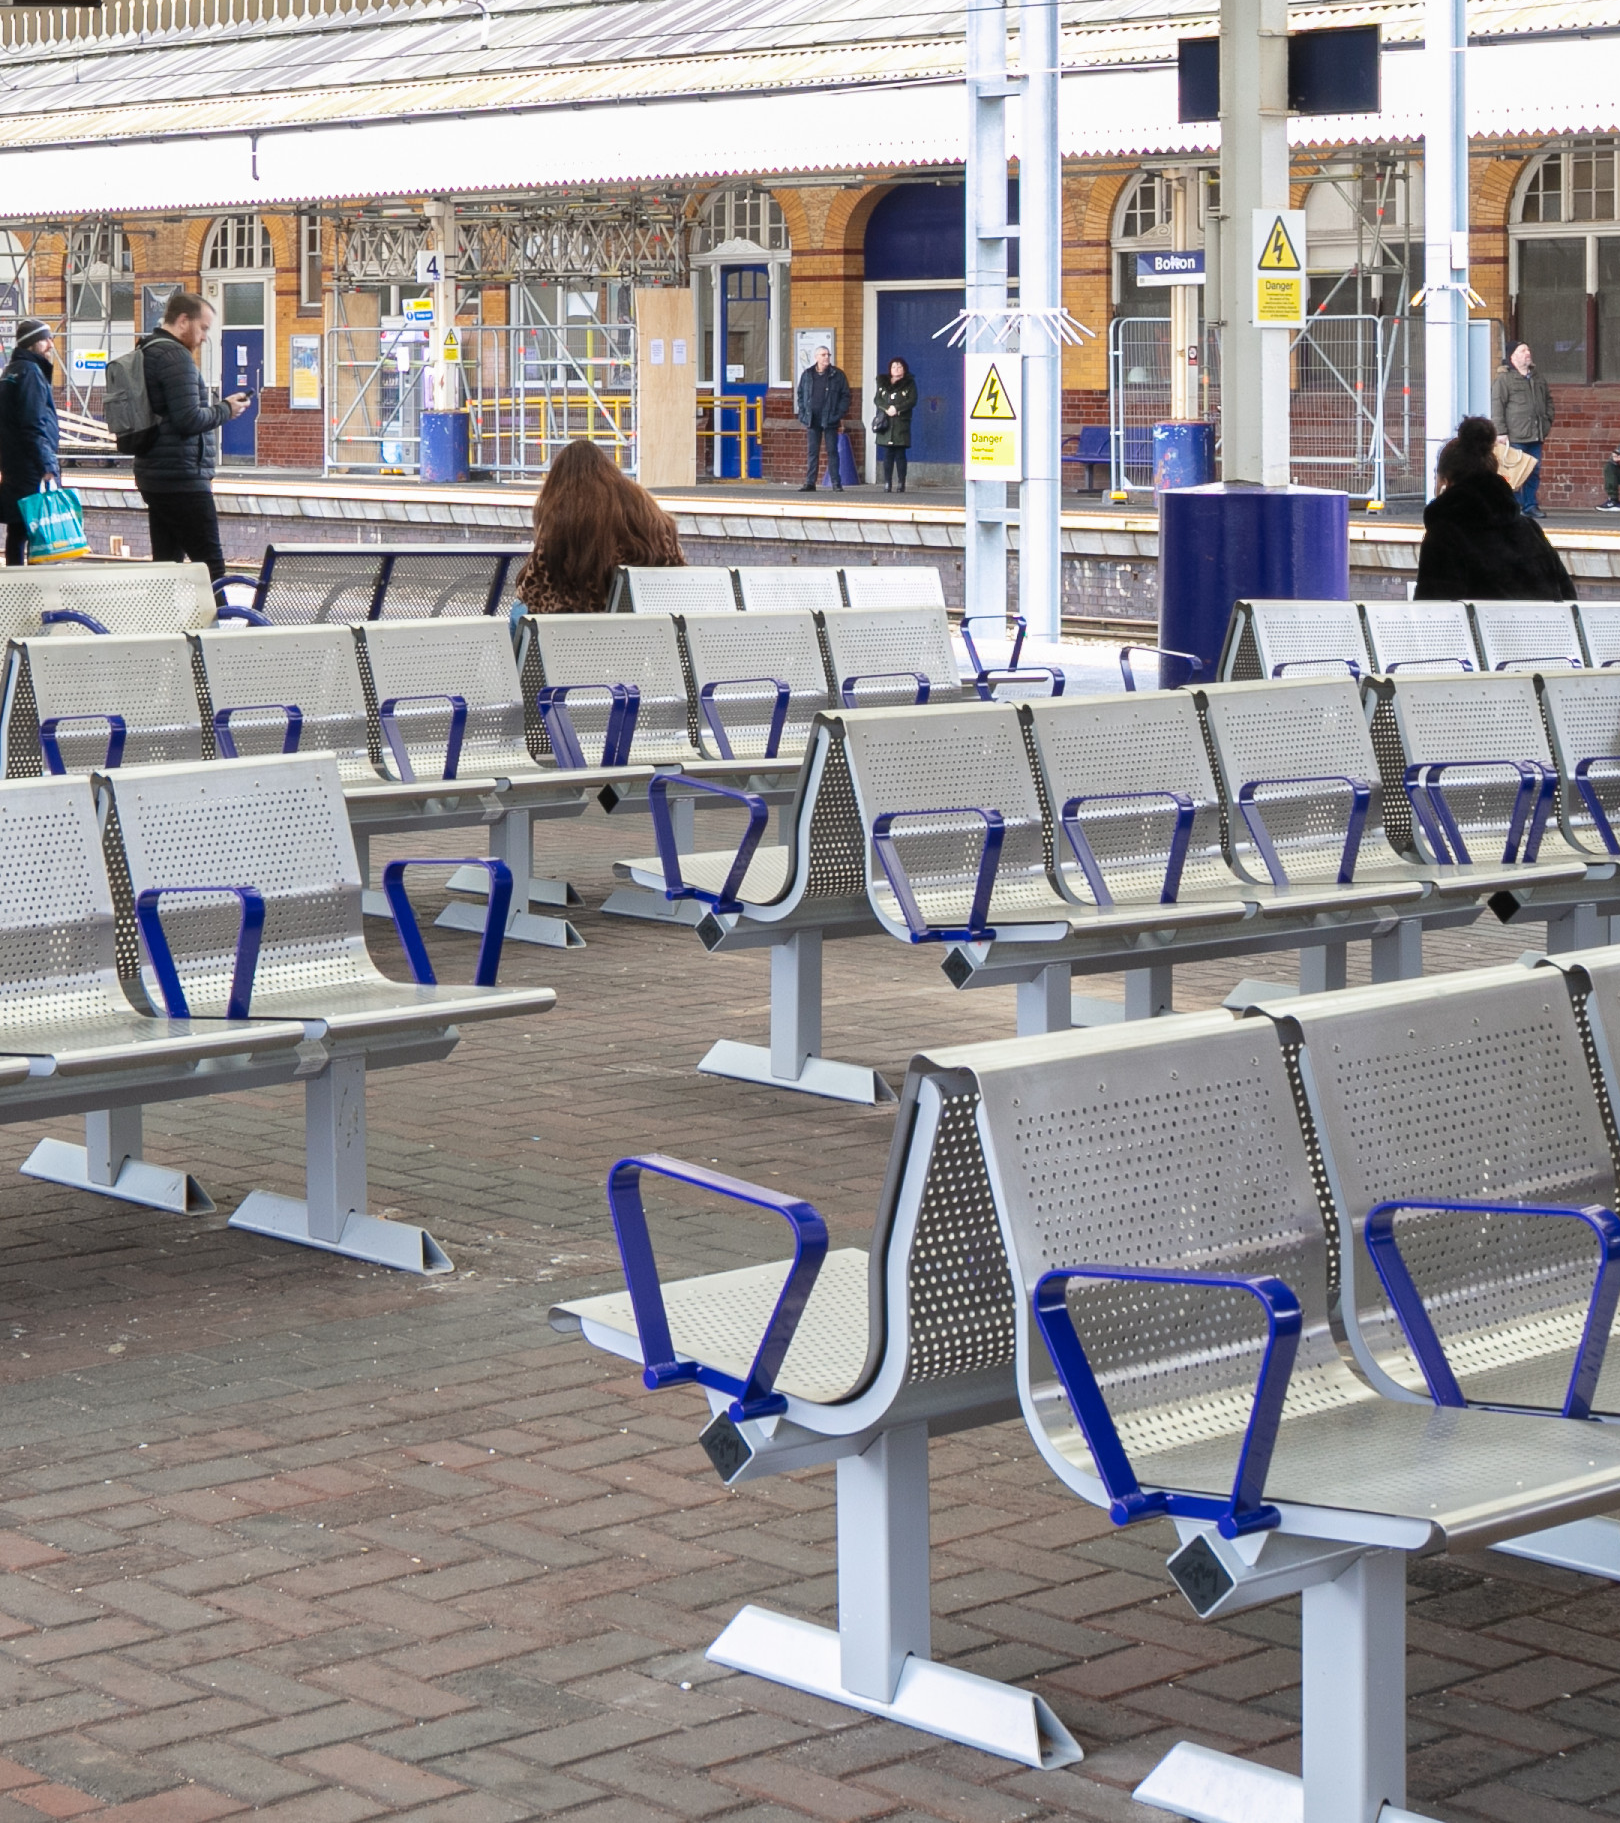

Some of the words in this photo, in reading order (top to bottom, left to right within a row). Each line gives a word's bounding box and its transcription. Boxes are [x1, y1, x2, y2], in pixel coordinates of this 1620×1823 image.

[427, 256, 438, 274] 4
[1155, 256, 1195, 271] Bolton
[1266, 281, 1293, 292] Danger
[972, 433, 1003, 445] Danger
